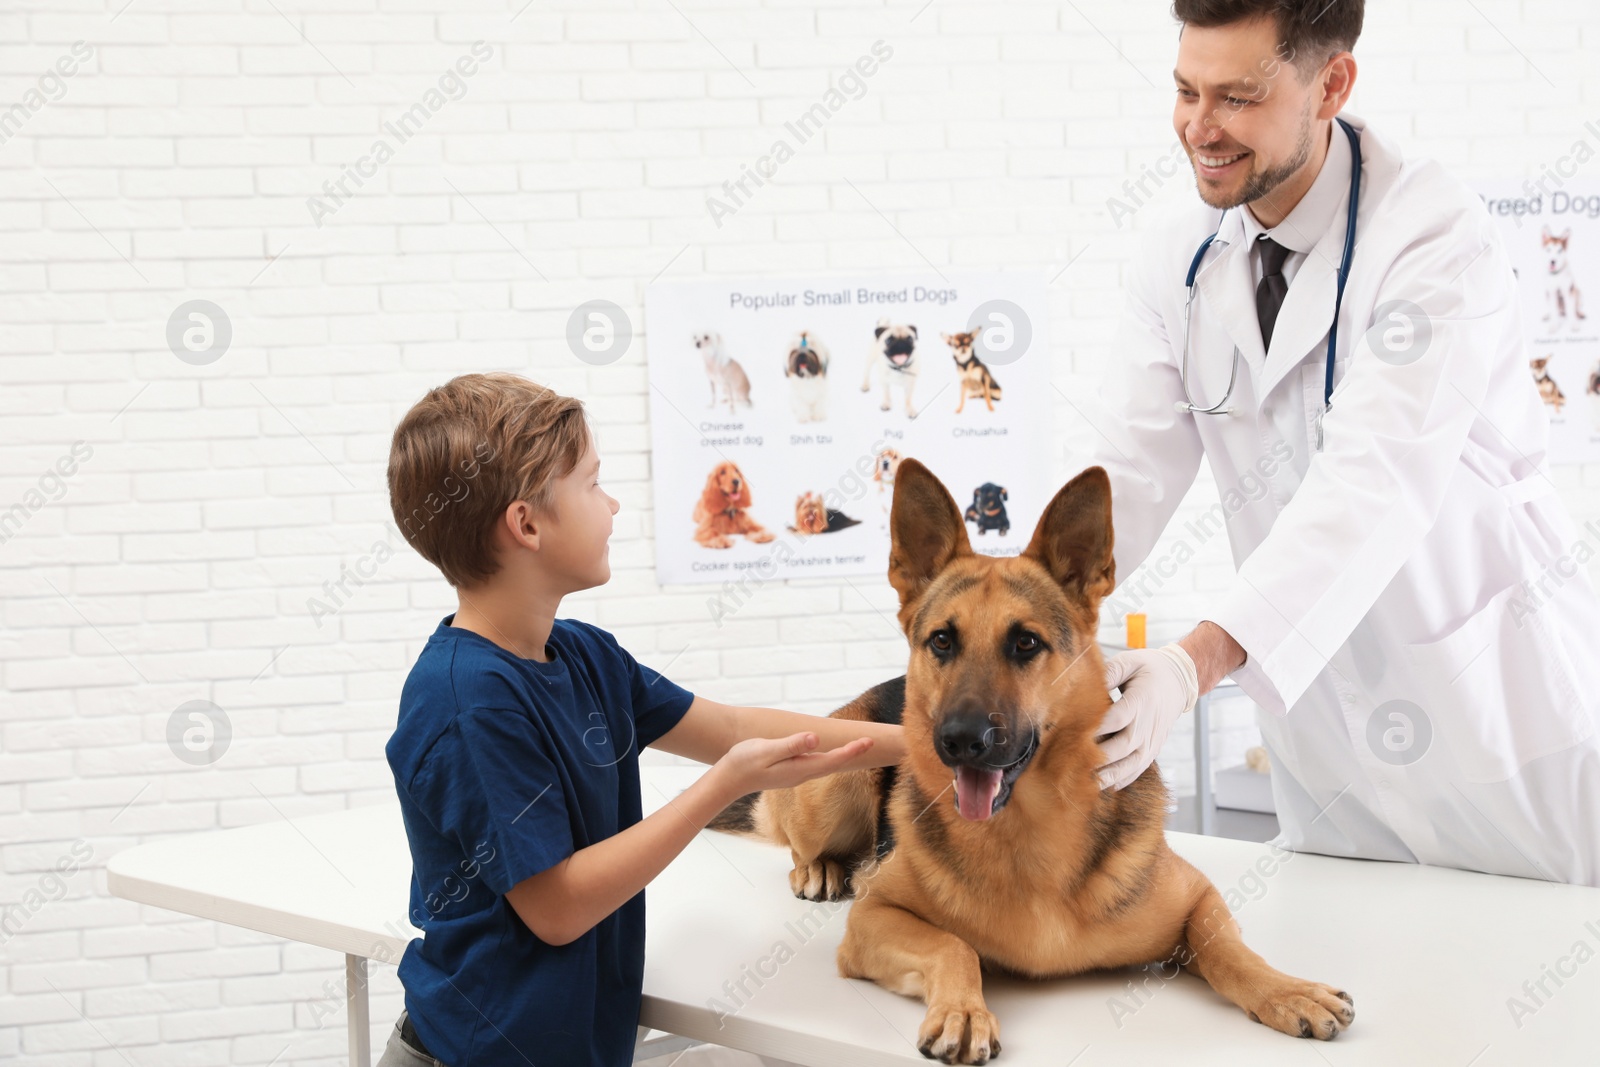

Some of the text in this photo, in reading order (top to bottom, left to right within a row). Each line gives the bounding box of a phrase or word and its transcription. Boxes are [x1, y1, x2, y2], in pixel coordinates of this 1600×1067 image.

[1479, 192, 1541, 216] reed
[730, 286, 957, 311] Popular Small Breed Dogs
[700, 422, 744, 432] Chinese
[953, 427, 1008, 438] Chihuahua
[790, 435, 813, 445] Shih
[884, 429, 903, 440] Pug
[700, 435, 763, 447] crested dog
[835, 554, 866, 565] terrier
[692, 562, 730, 572] Cocker
